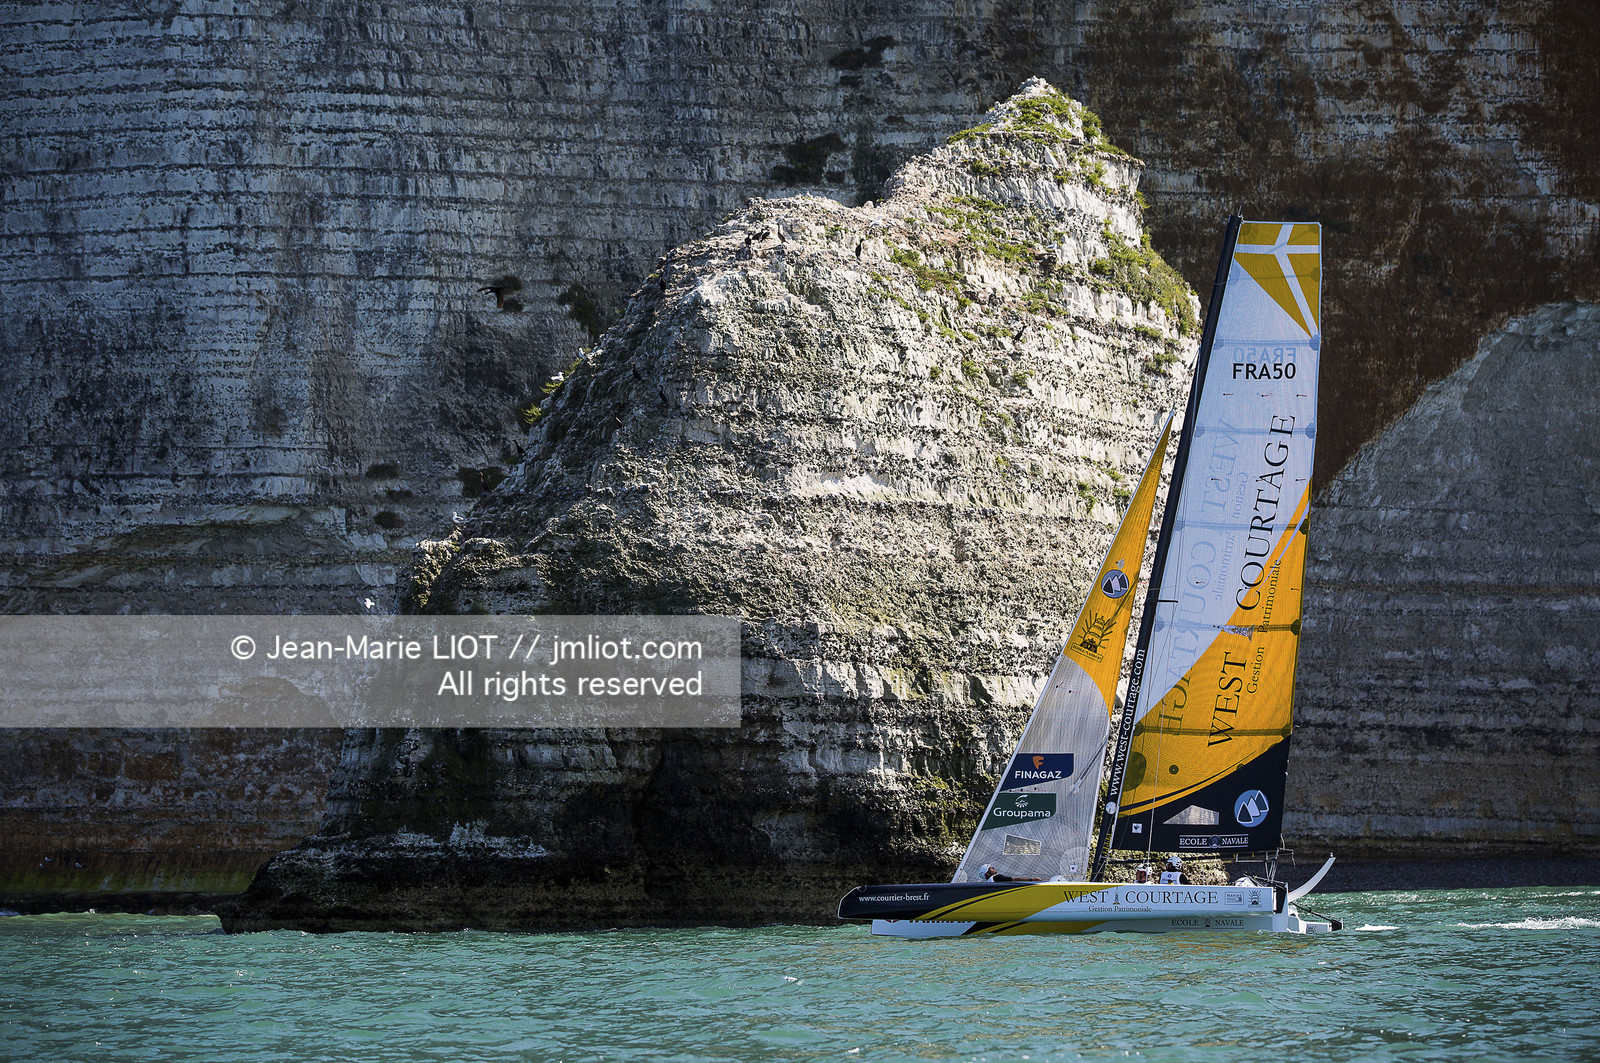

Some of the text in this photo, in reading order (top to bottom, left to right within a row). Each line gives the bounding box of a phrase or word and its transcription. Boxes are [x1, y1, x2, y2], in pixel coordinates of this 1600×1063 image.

[1233, 362, 1296, 380] FRA50
[1208, 415, 1296, 747] WEST COURTAGE
[1247, 559, 1282, 694] Gestion Patrimoniale
[1110, 648, 1145, 796] www.west-courtage.com
[1014, 770, 1062, 779] FINAGAZ
[993, 807, 1051, 819] Groupama
[1179, 837, 1248, 846] ECOLE NAVALE
[858, 892, 930, 902] www.courtier-brest.fr
[1063, 891, 1109, 904] WEST
[1125, 891, 1219, 904] COURTAGE
